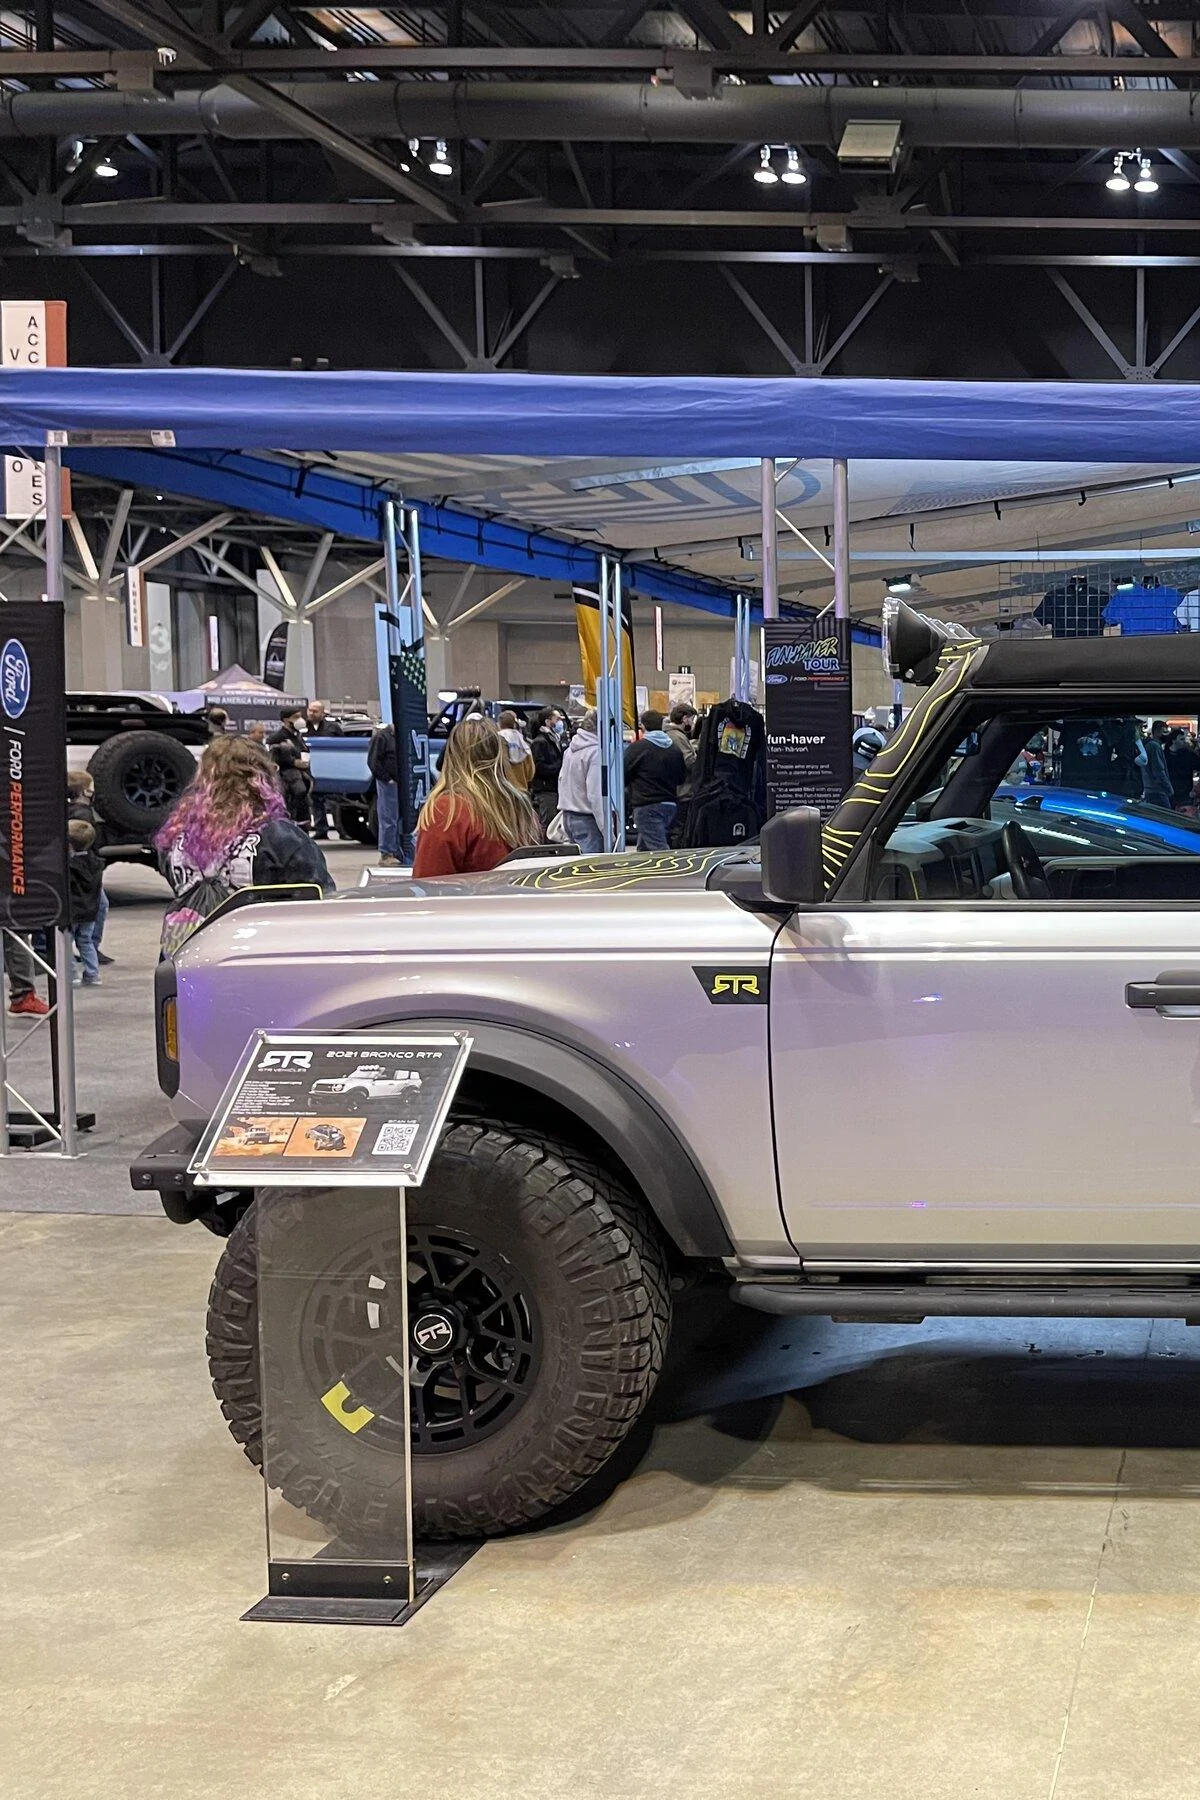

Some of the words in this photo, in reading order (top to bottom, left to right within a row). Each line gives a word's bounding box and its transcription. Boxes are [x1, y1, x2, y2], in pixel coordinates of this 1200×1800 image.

[804, 657, 840, 671] TOUR
[4, 653, 27, 704] Ford
[767, 734, 826, 744] fun-haver
[9, 739, 22, 780] FORD
[9, 781, 25, 895] PERFORMANCE
[711, 974, 761, 995] RTR
[257, 1050, 314, 1069] RTR
[360, 1051, 414, 1059] BRONCO
[416, 1321, 451, 1345] RTR
